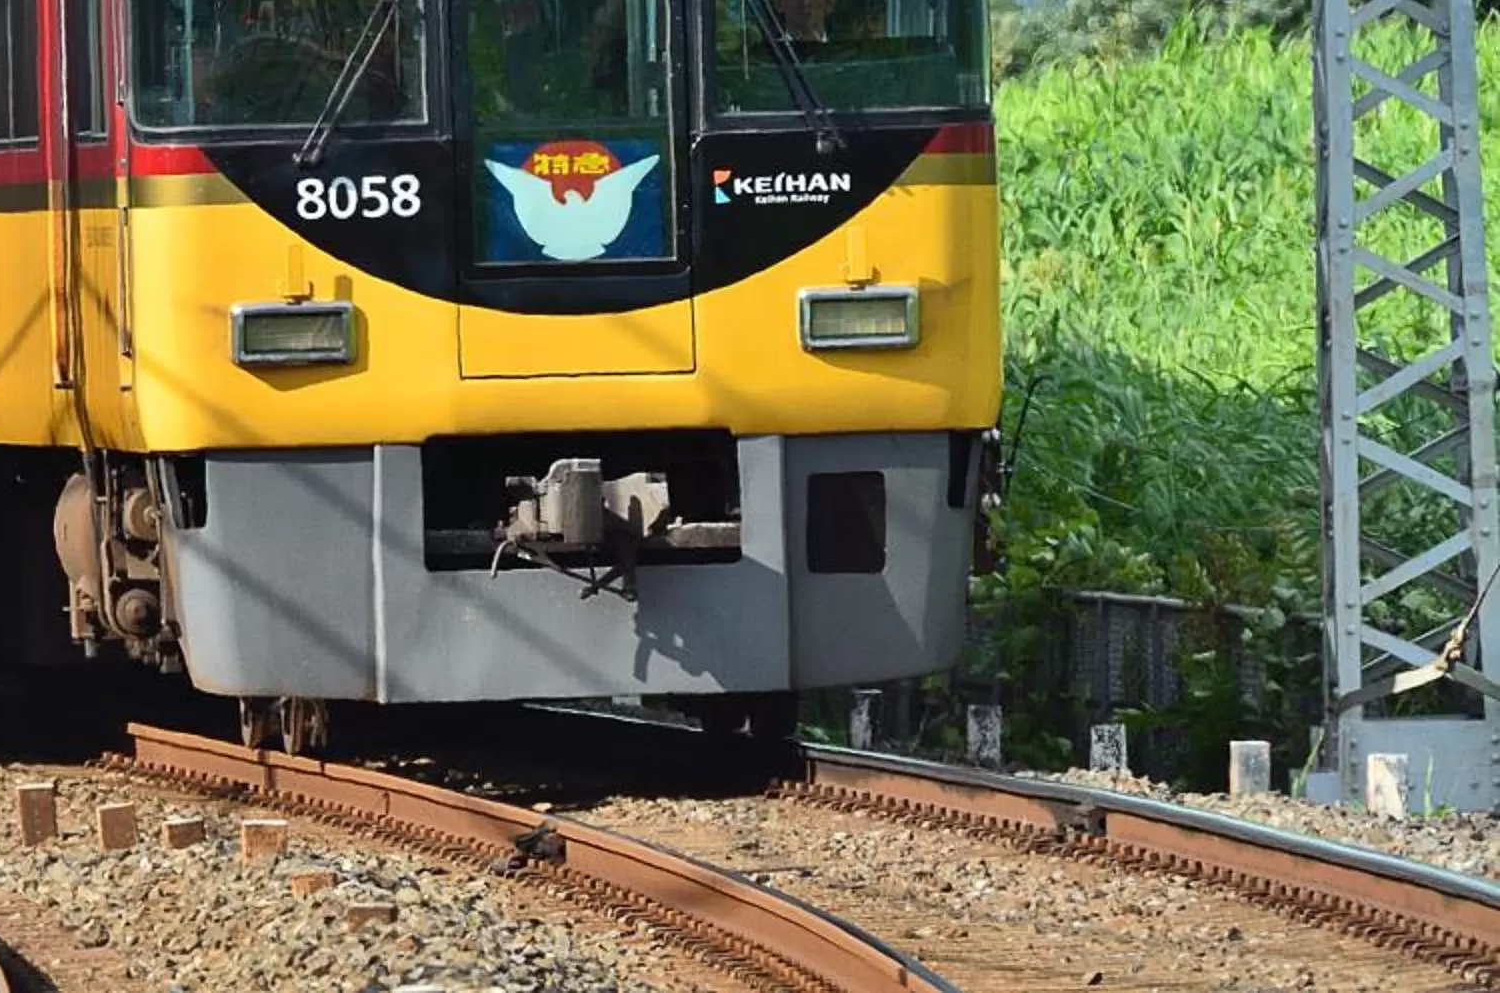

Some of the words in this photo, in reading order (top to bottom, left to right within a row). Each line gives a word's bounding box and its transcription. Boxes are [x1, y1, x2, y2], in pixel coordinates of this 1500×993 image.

[533, 152, 610, 175] 特急
[734, 171, 851, 195] KEIHAN
[296, 174, 421, 220] 8058
